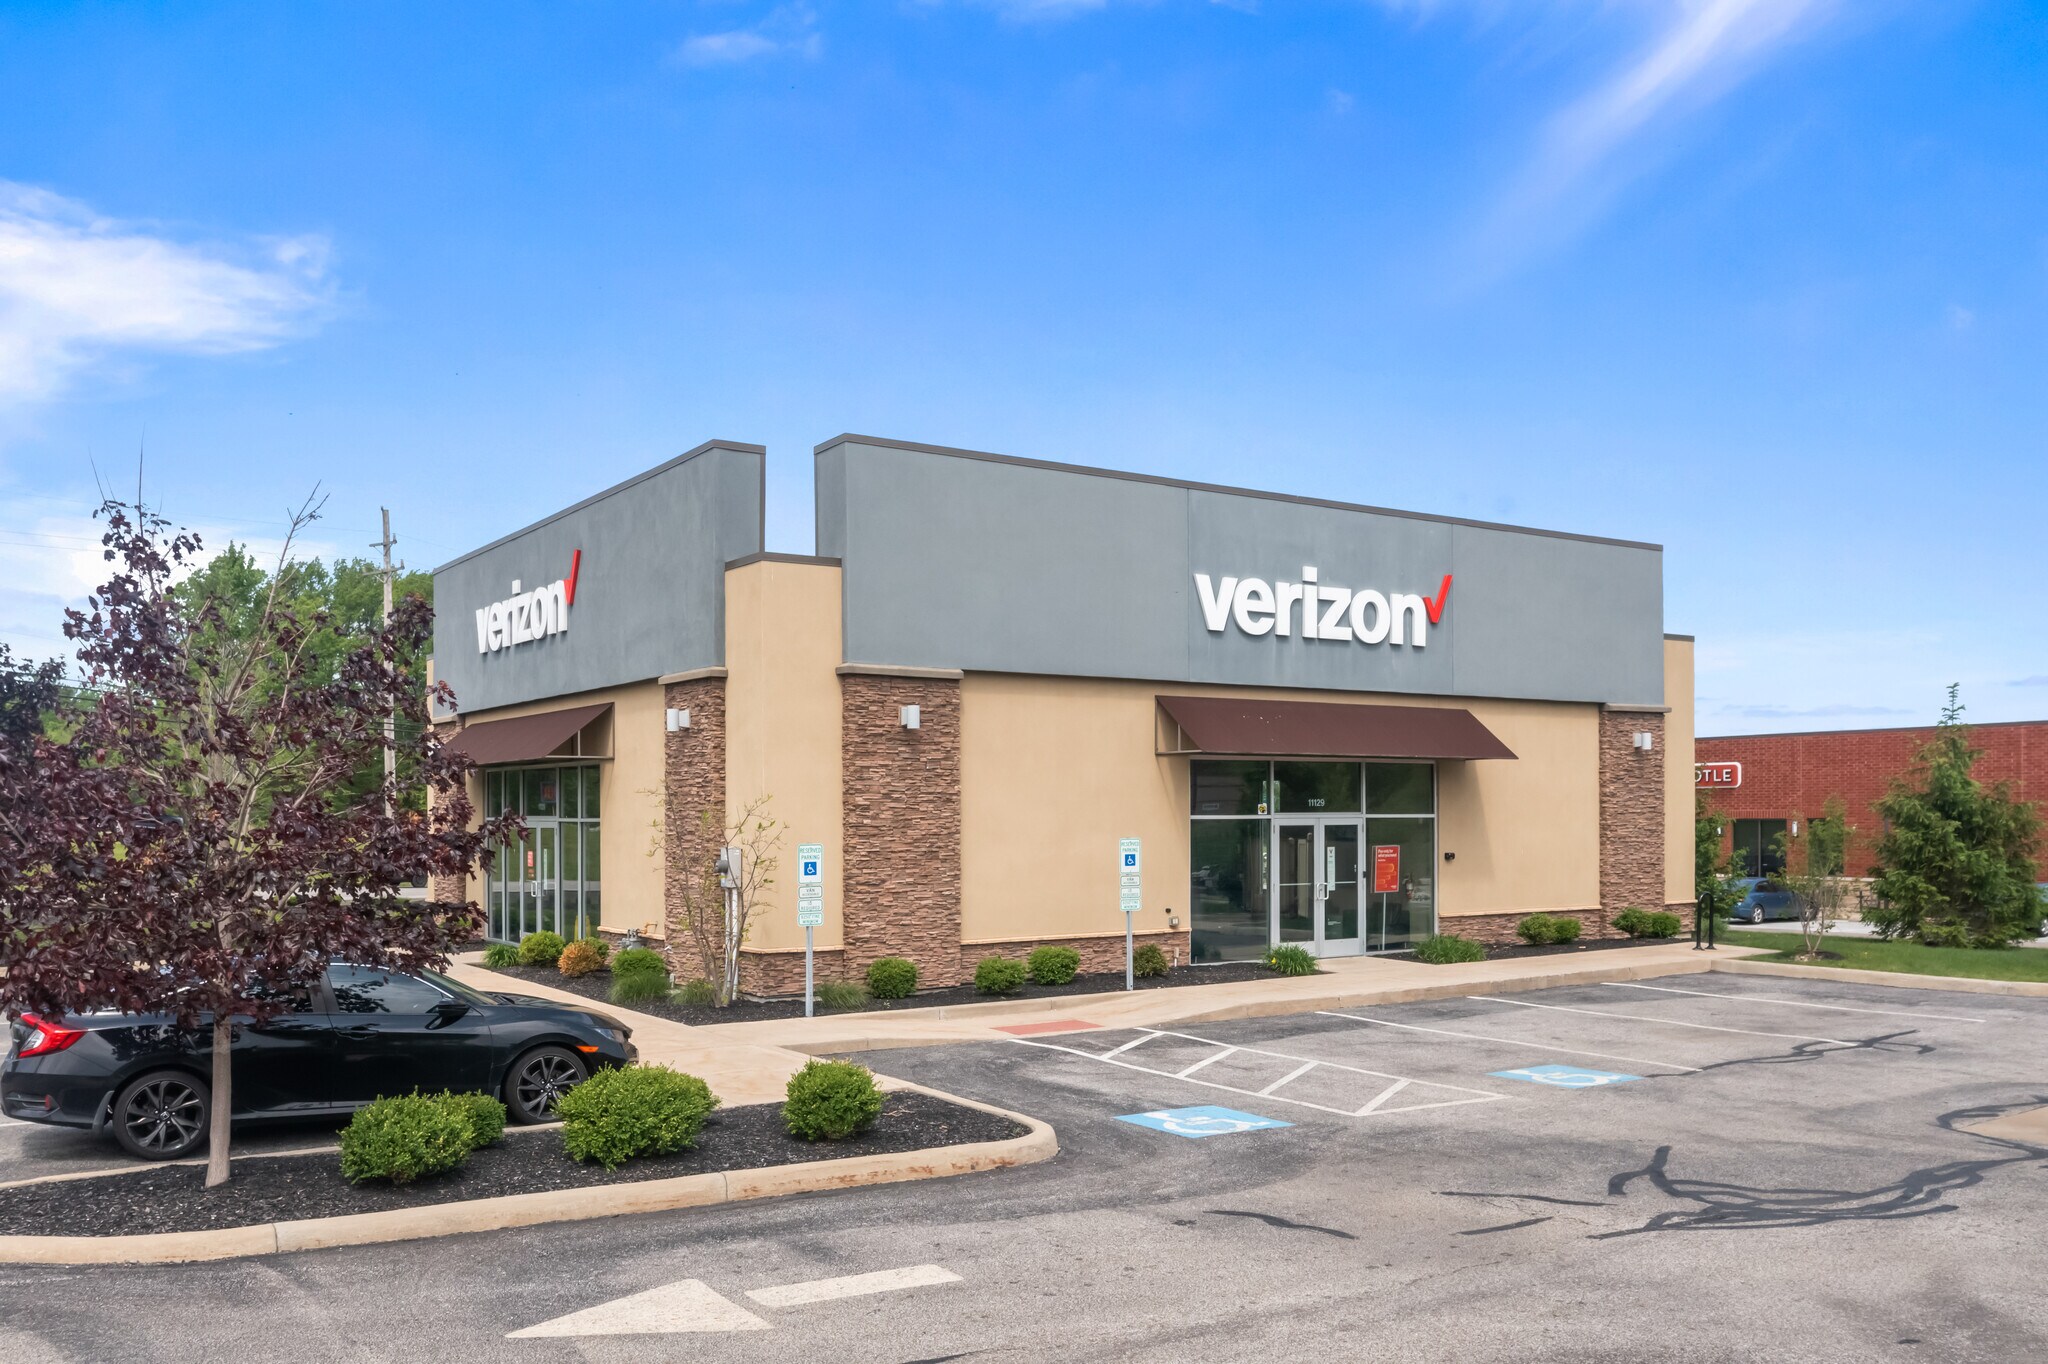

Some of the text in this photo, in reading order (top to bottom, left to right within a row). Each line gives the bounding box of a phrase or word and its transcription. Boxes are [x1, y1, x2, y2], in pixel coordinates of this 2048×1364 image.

[475, 579, 568, 654] verizon
[1194, 566, 1427, 647] verizon
[1308, 798, 1325, 807] 11129
